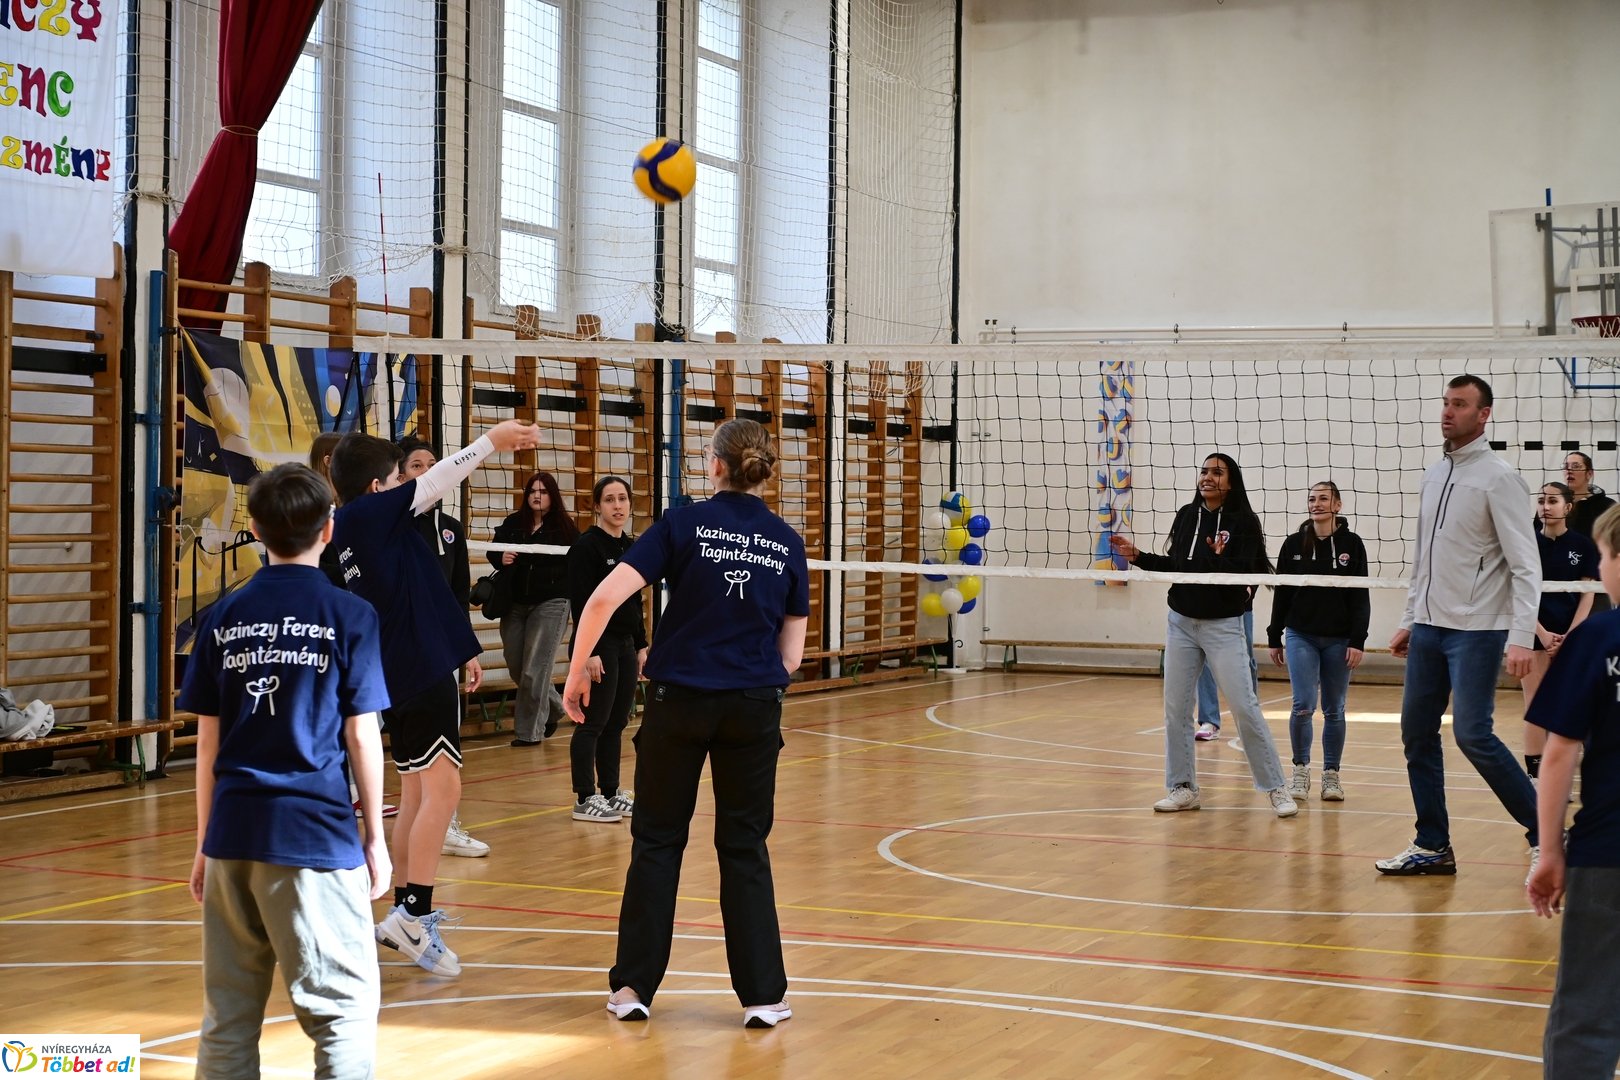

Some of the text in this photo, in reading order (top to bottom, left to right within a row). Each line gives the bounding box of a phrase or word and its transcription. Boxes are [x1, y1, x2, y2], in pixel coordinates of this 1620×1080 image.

[454, 451, 477, 466] KIPSTA
[696, 525, 790, 556] Kazinczy Ferenc
[699, 542, 786, 575] Tagintézmény
[213, 616, 336, 646] Kazinczy Ferenc
